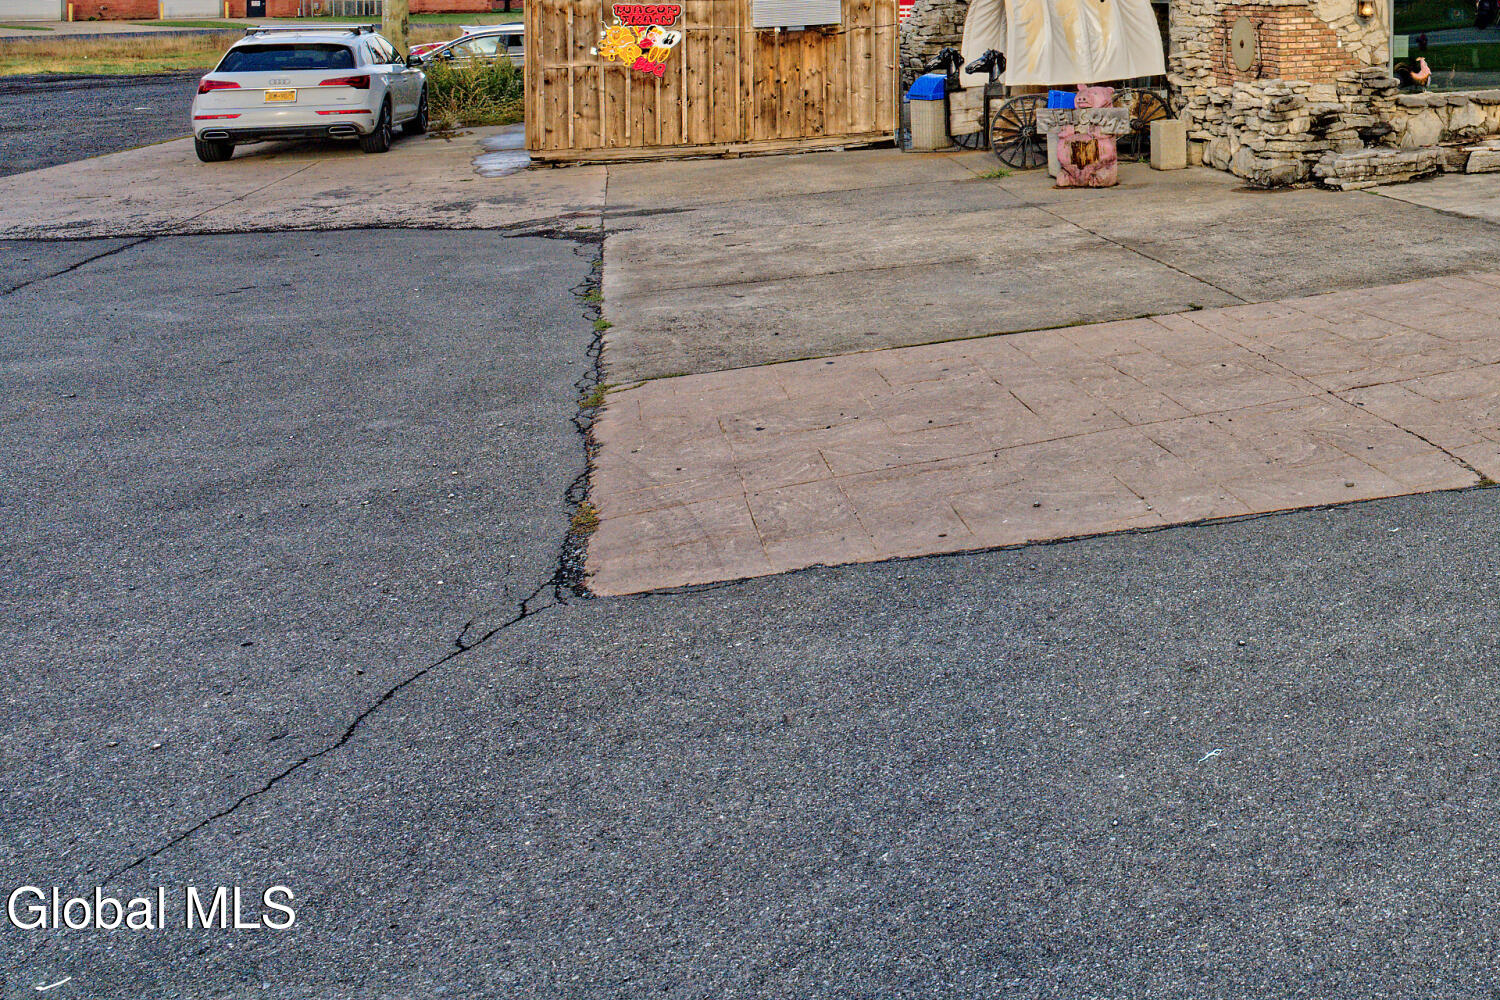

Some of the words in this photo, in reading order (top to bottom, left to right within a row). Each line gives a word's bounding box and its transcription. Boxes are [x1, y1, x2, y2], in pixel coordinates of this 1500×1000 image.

[612, 4, 682, 16] WAGON
[632, 56, 667, 78] BBQ
[1041, 108, 1128, 132] WELCOME
